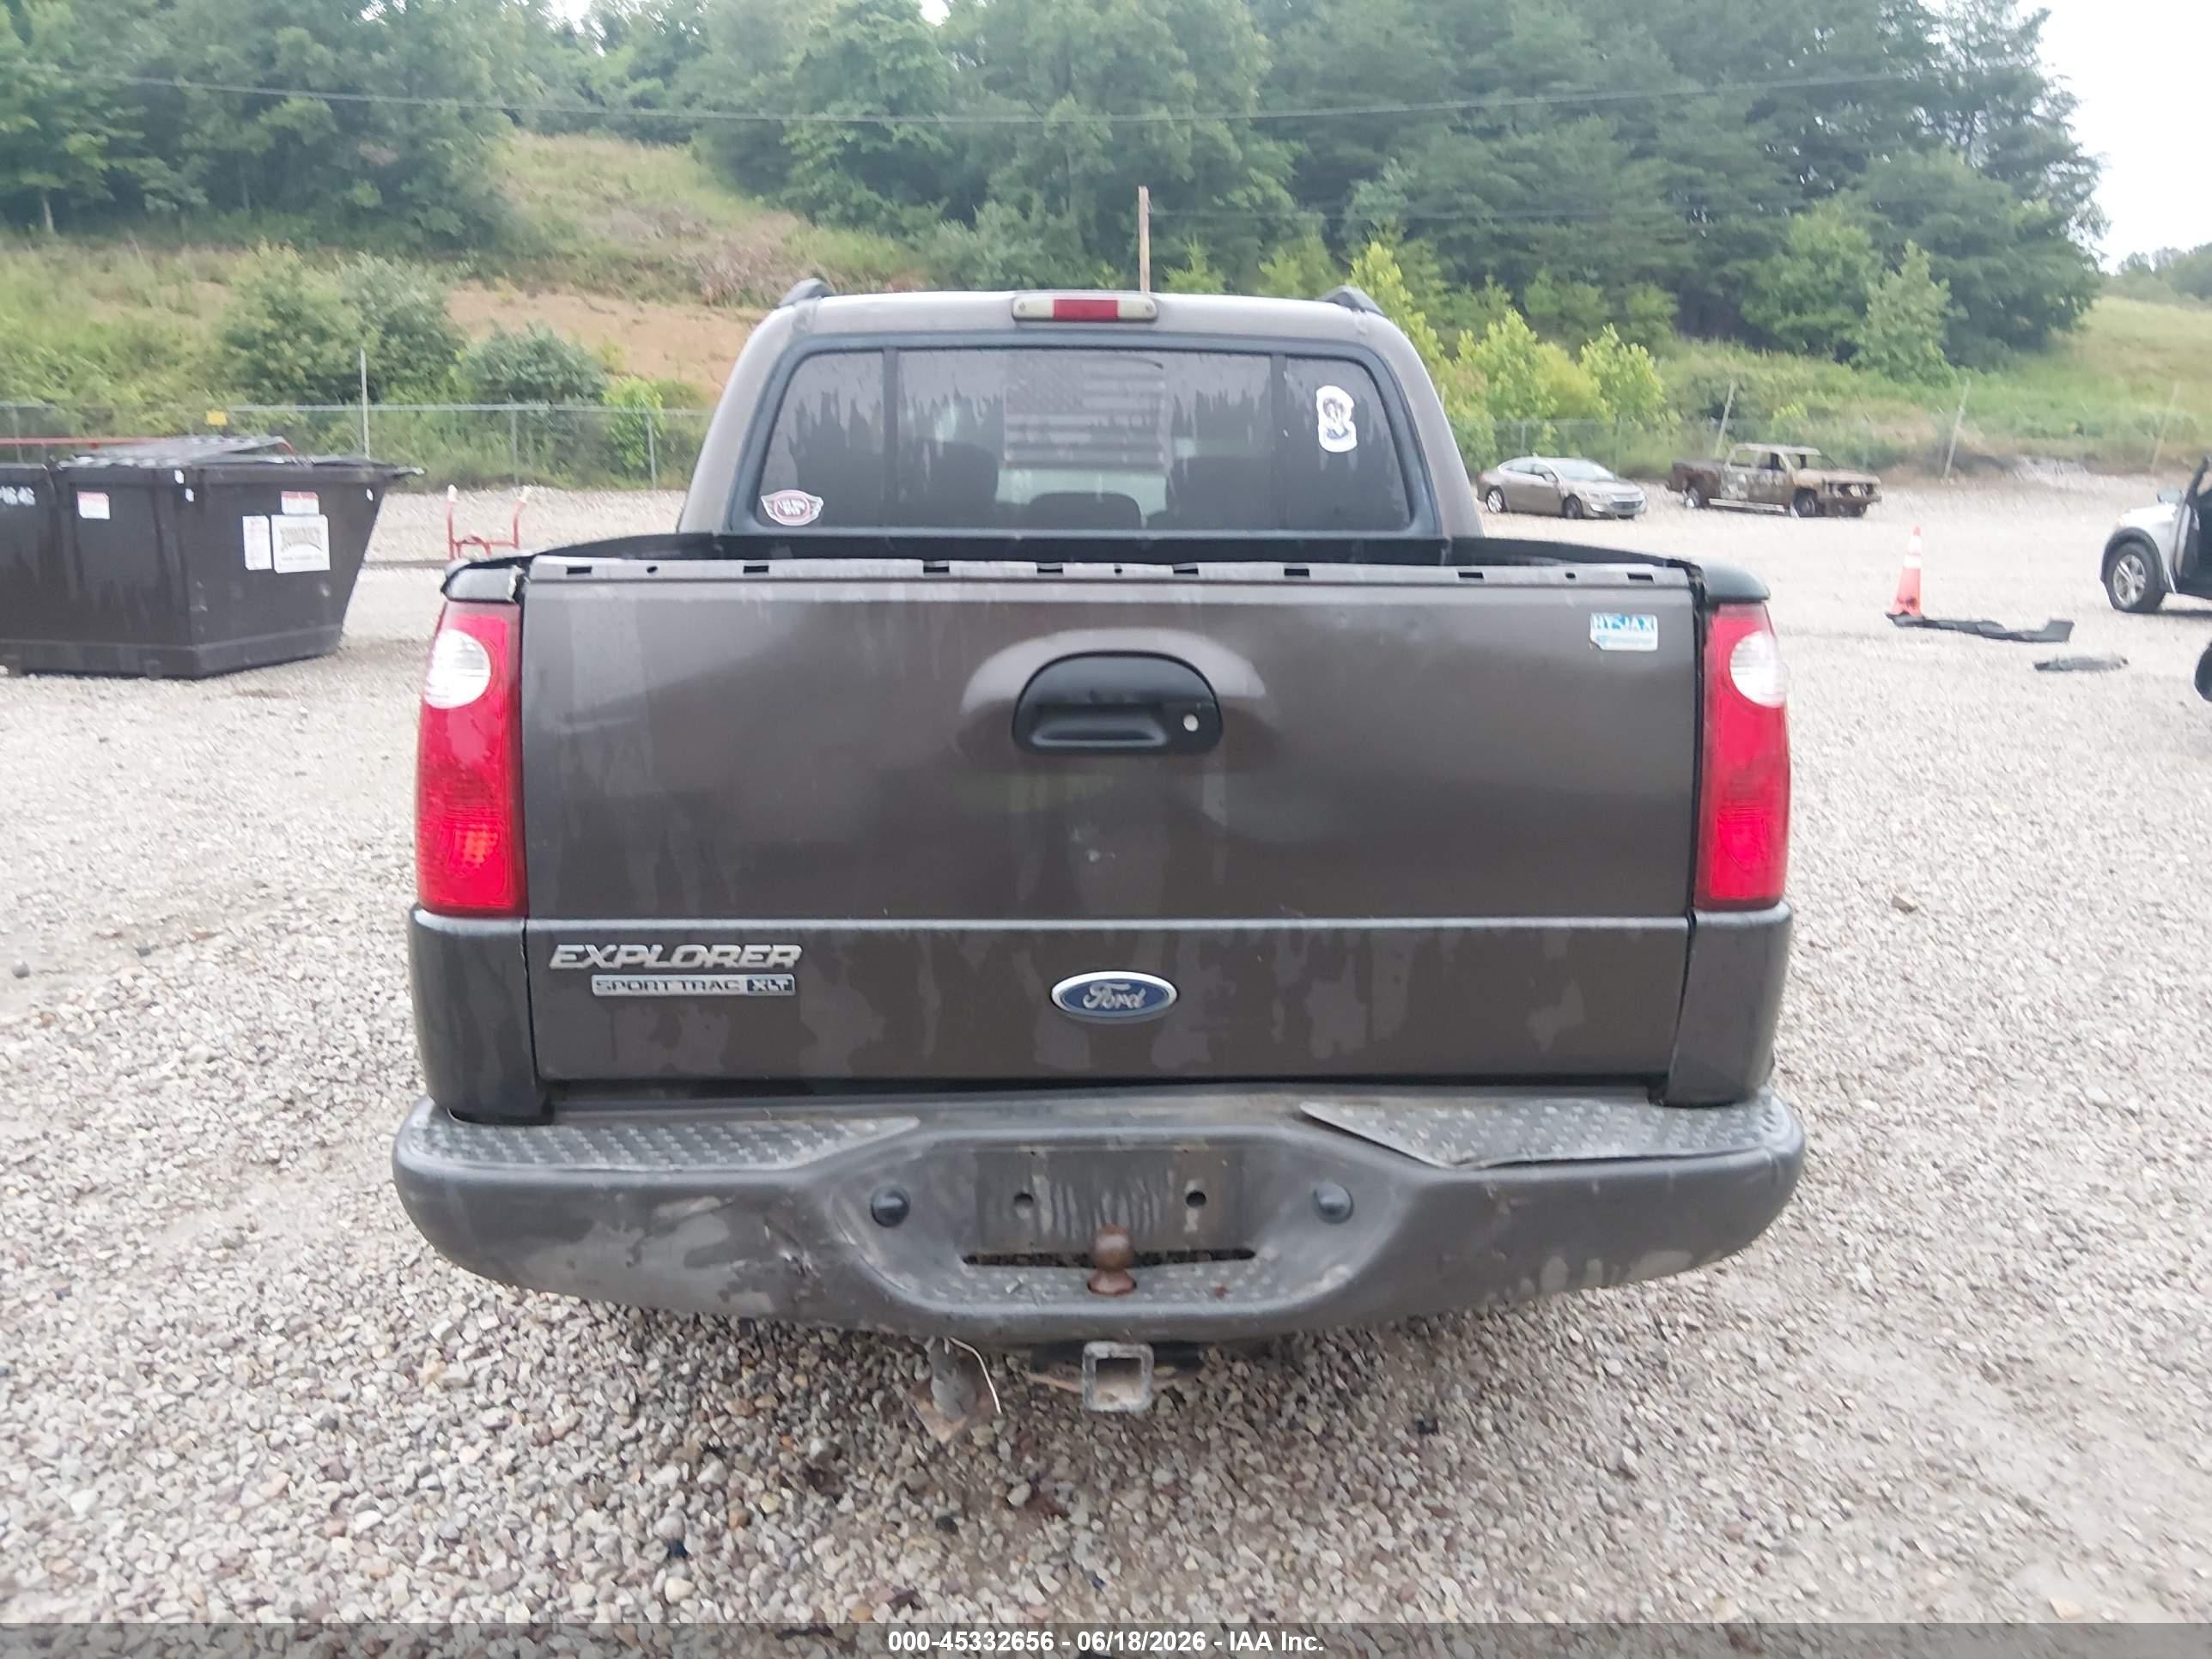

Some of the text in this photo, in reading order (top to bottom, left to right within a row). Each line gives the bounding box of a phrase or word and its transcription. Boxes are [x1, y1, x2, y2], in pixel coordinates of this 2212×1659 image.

[550, 944, 803, 969] EXPLORER
[595, 978, 788, 992] SPORT TRAC XLT
[1082, 981, 1146, 1009] Ford
